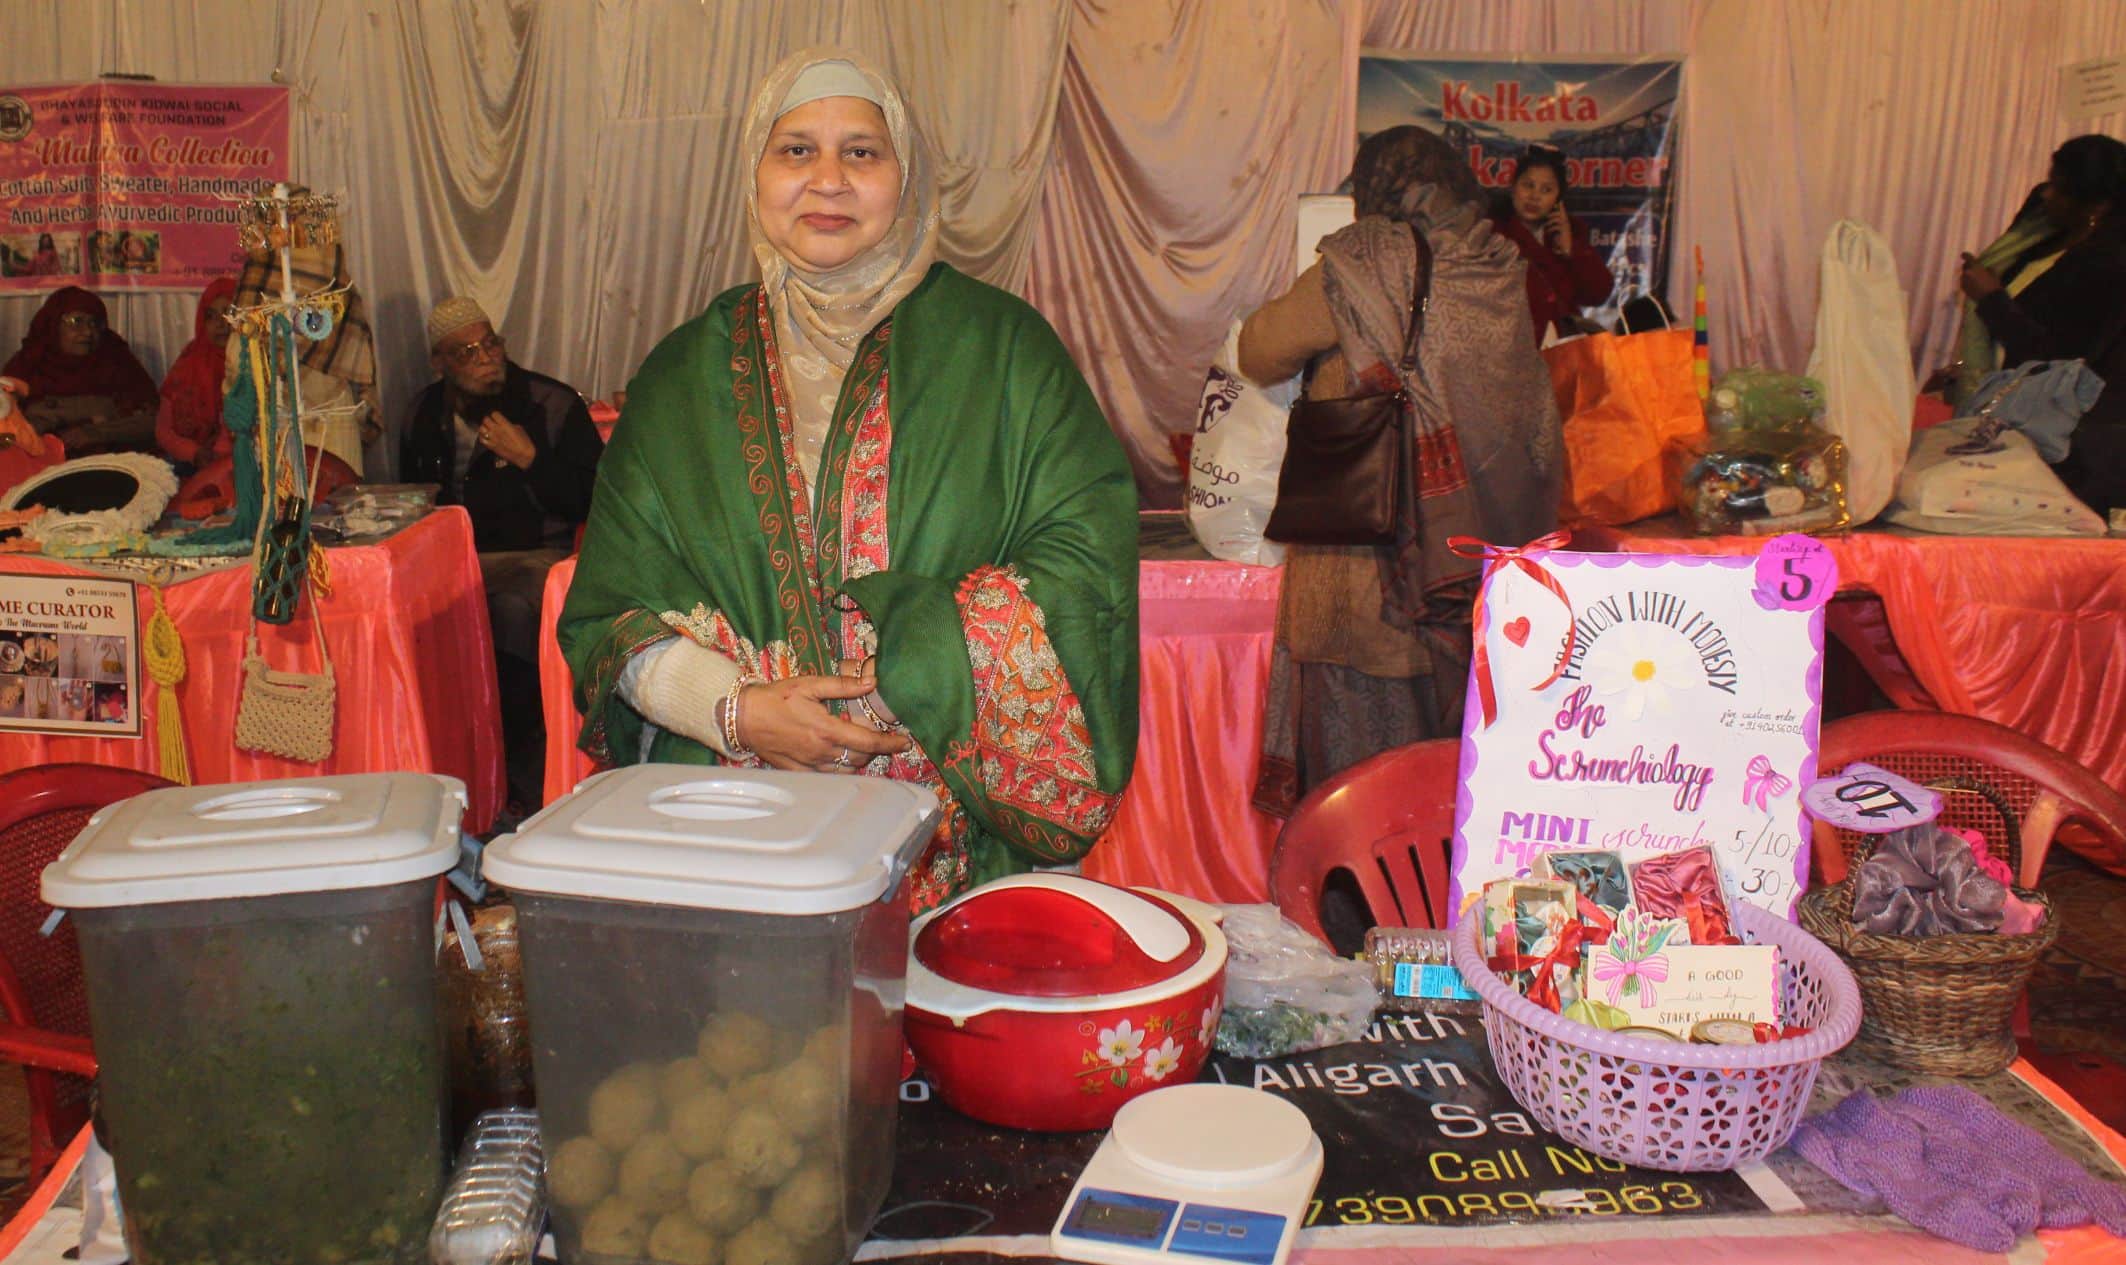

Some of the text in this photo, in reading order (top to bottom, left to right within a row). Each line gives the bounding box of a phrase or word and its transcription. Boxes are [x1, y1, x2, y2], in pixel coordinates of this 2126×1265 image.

[193, 99, 242, 112] SOCIAL
[1442, 81, 1598, 122] Kolkata
[140, 113, 225, 126] FOUNDATION
[150, 136, 272, 165] Collection
[1564, 154, 1669, 188] orner
[11, 206, 43, 224] And
[99, 203, 180, 223] Ayurvedic
[186, 206, 249, 224] Produc
[27, 602, 116, 619] CURATOR
[1627, 591, 1686, 629] WITH
[1555, 684, 1607, 738] The
[1528, 730, 1713, 812] Scrunchiology
[1501, 811, 1594, 845] MINI
[1688, 969, 1744, 981] A GOOD
[1253, 1056, 1467, 1096] Aligarh
[1429, 1149, 1529, 1183] Call
